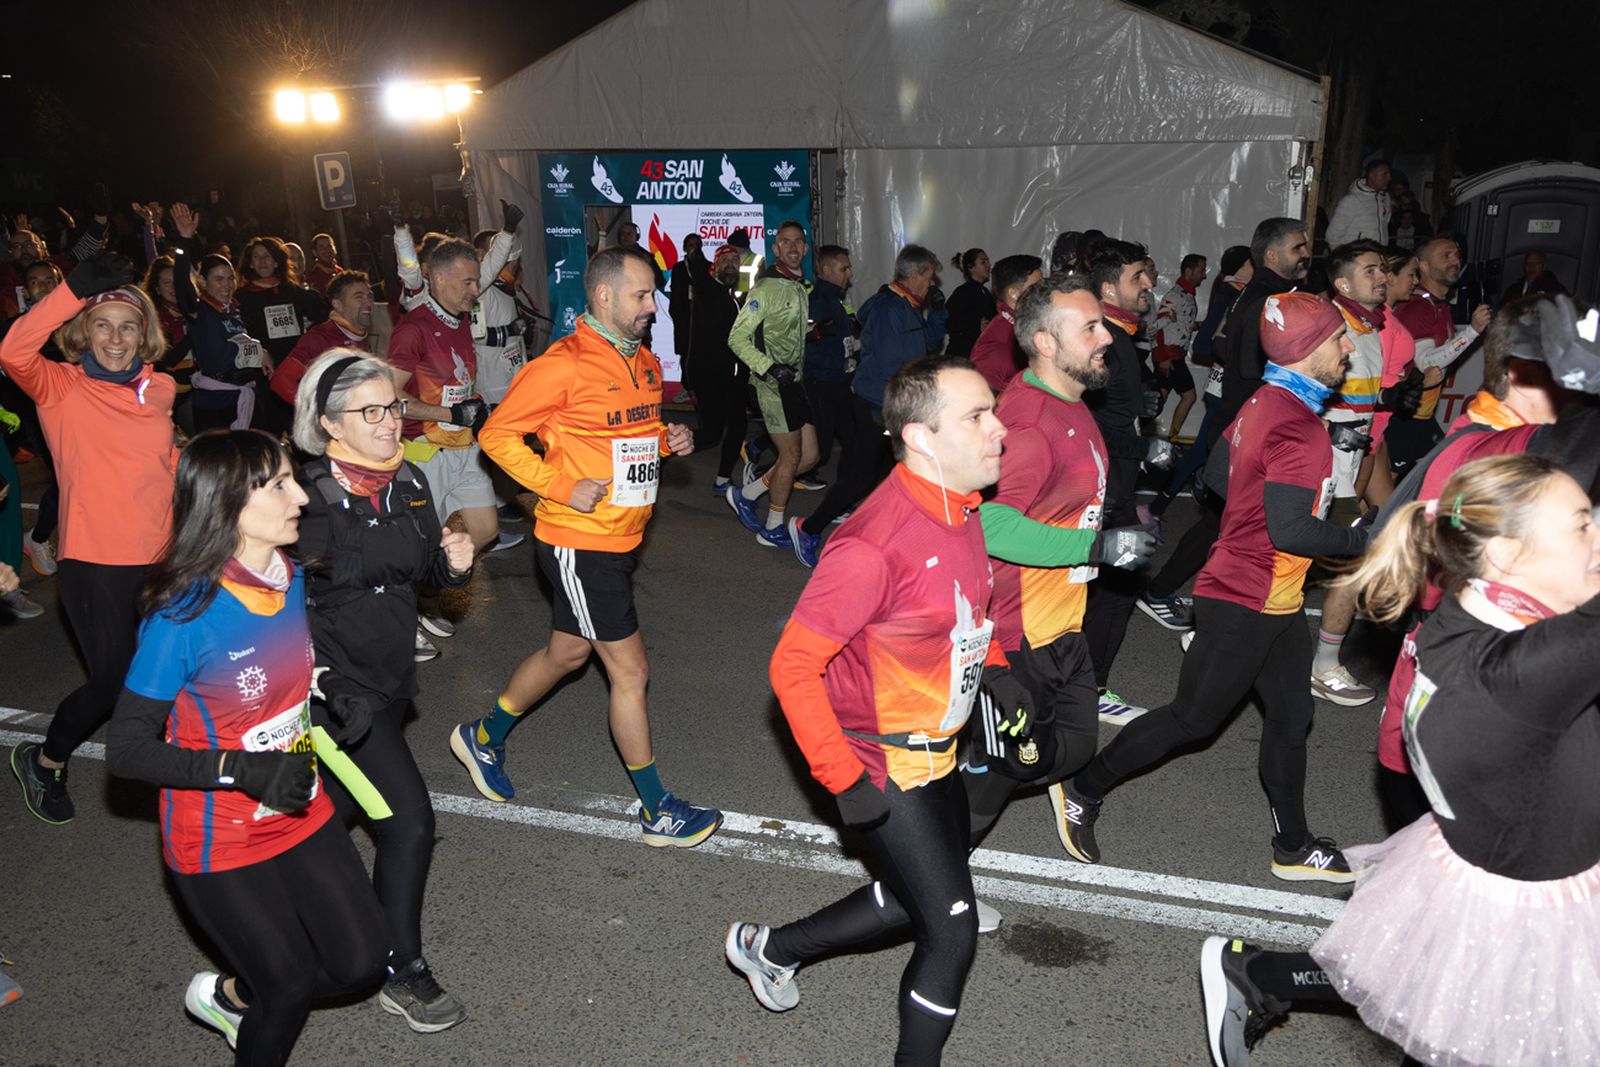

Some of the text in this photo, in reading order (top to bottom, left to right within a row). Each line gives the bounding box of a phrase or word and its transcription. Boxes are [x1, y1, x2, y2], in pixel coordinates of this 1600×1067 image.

[324, 160, 345, 202] P
[636, 176, 701, 200] ANTÓN
[729, 181, 742, 195] 43
[600, 182, 613, 196] 43
[700, 225, 729, 240] SAN
[607, 410, 622, 426] LA
[621, 454, 636, 463] SAN
